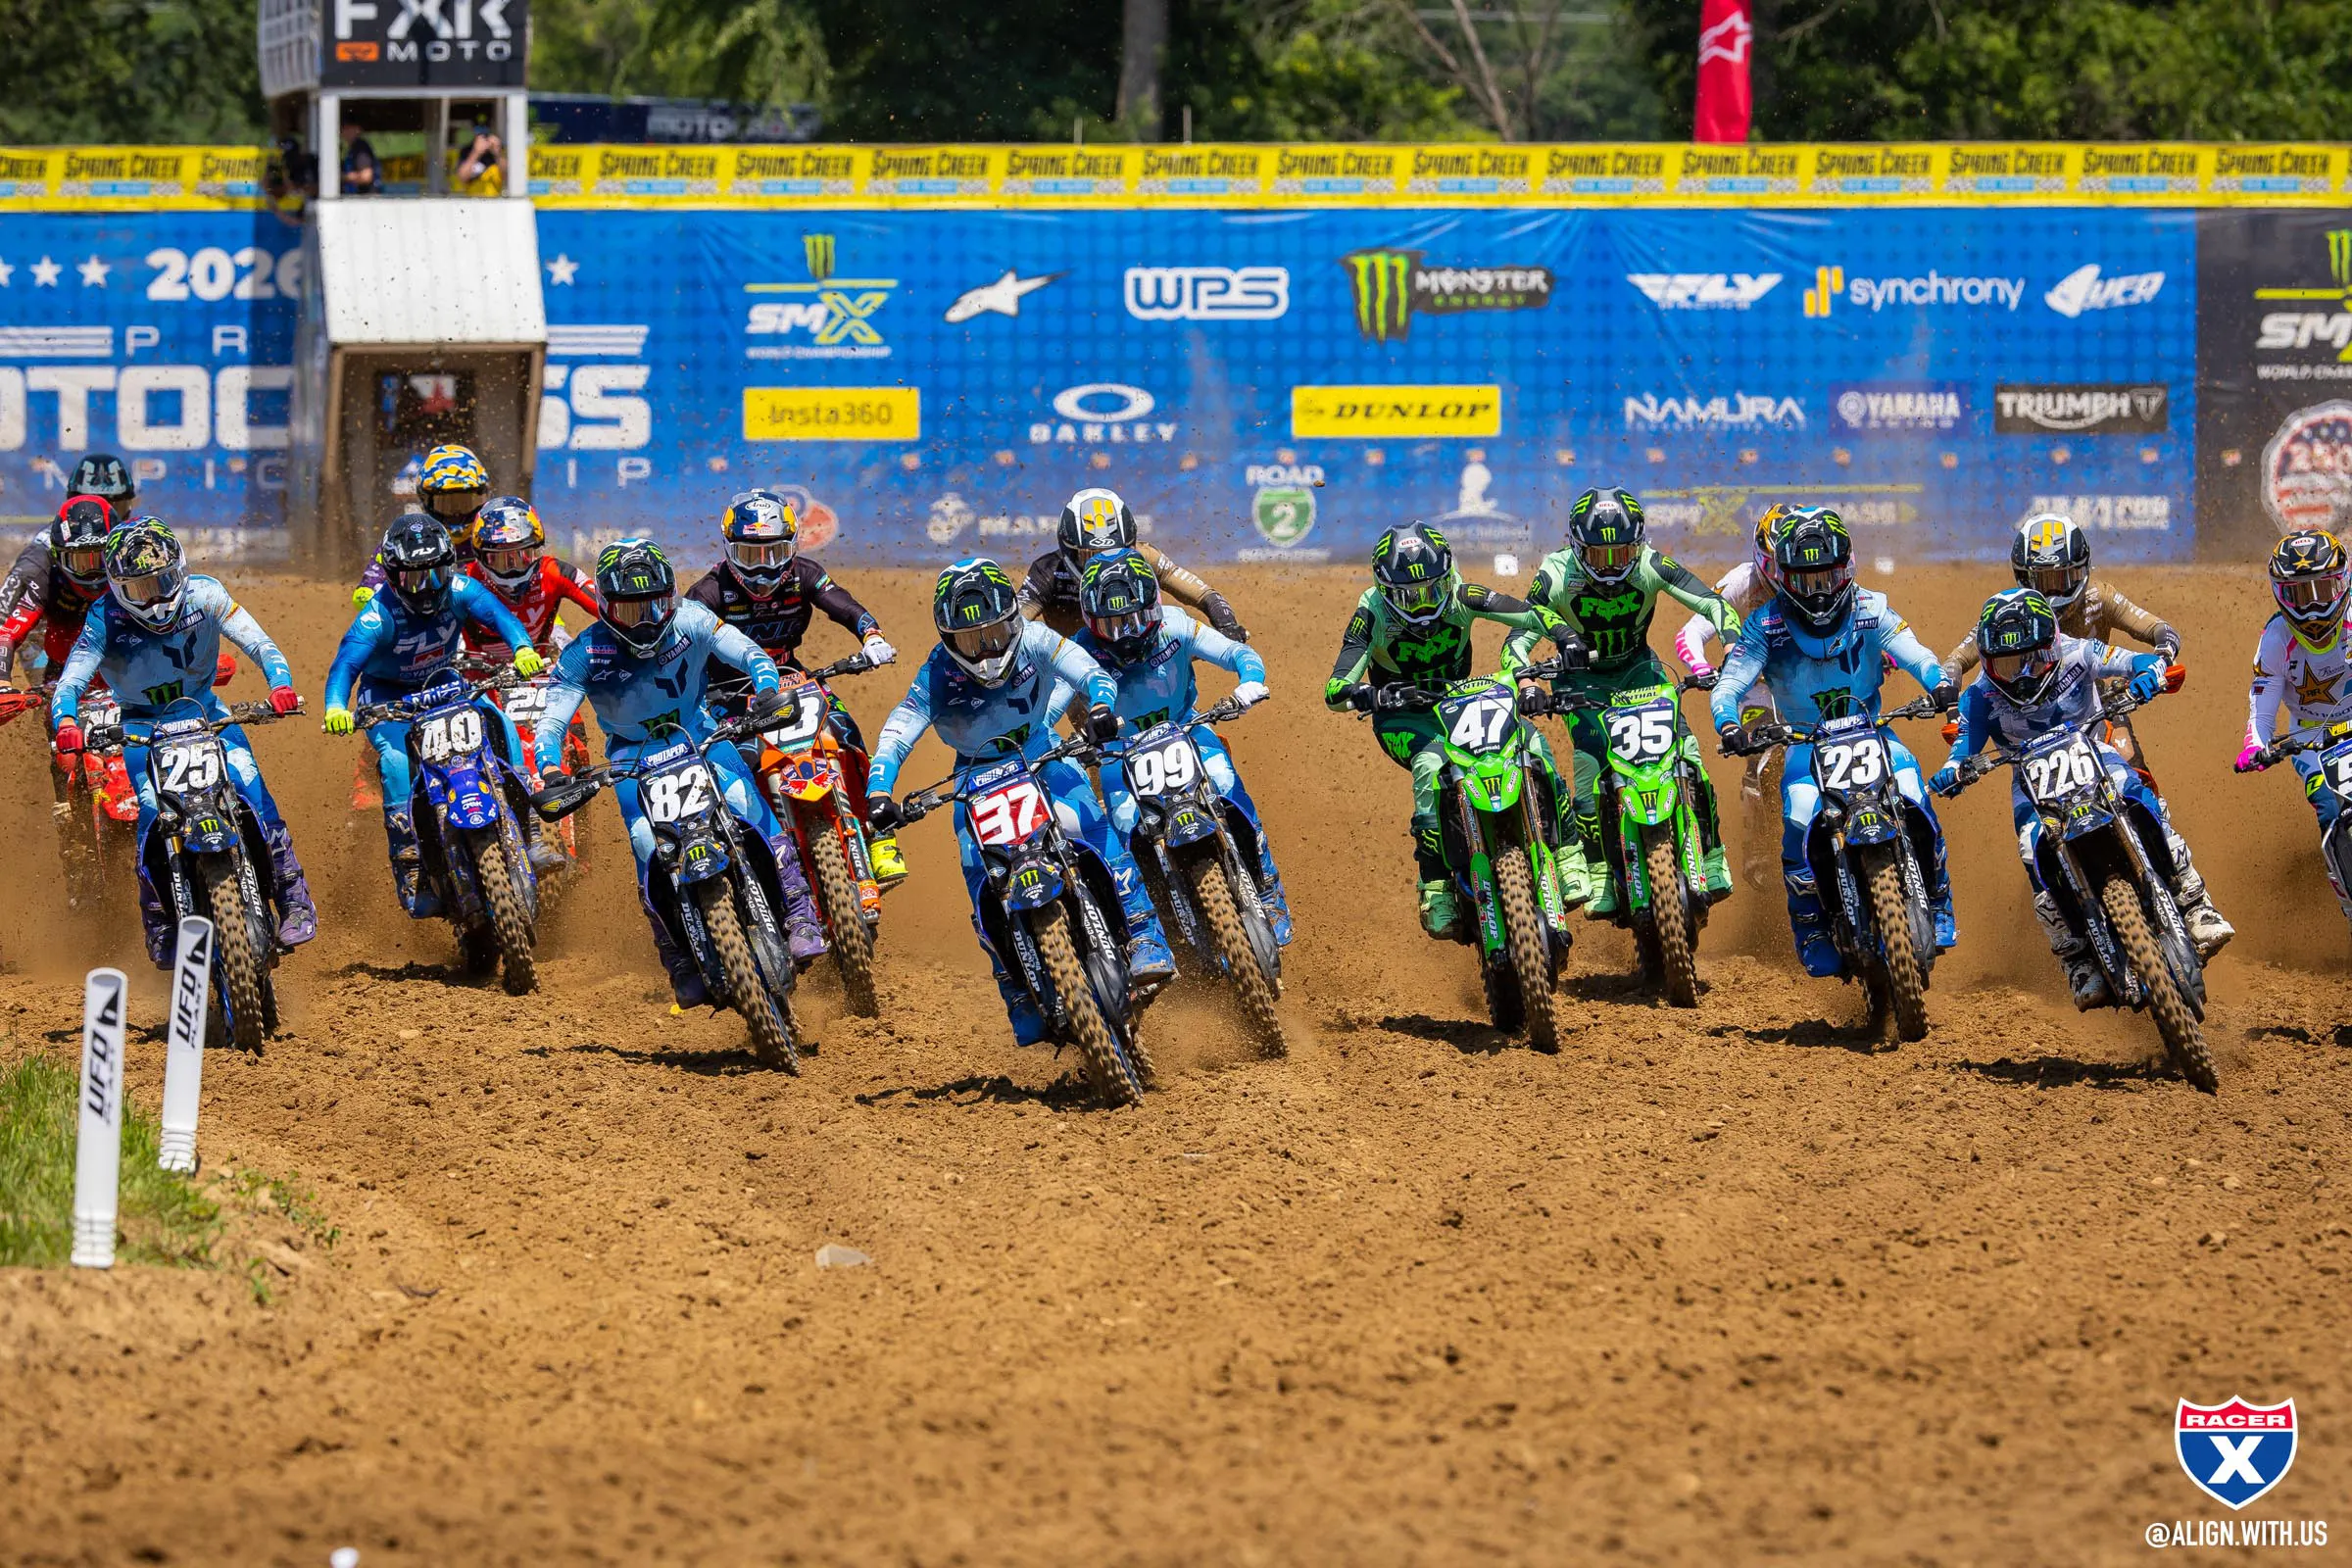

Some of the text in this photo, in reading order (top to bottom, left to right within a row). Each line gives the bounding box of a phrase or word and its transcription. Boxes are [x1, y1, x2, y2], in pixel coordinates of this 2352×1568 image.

[386, 40, 513, 62] MOTO
[1125, 267, 1290, 319] WPS
[1414, 268, 1549, 294] MONSTER
[1849, 269, 2027, 312] synchrony
[745, 291, 889, 344] SMX
[2256, 311, 2352, 363] SM
[1334, 403, 1492, 419] DUNLOP
[1624, 391, 1807, 424] NAMURA
[1866, 392, 1961, 419] YAMAHA
[1995, 392, 2132, 421] TRIUMPH
[1029, 422, 1177, 443] OAKLEY
[1246, 465, 1323, 488] ROAD
[1271, 500, 1298, 538] 2
[411, 546, 435, 558] FLY
[392, 620, 458, 655] FLY
[2057, 665, 2084, 695] YAMAHA
[420, 710, 482, 761] 40
[1449, 697, 1513, 749] 47
[1610, 710, 1673, 761] 35
[161, 741, 220, 793] 25
[1134, 740, 1195, 796] 99
[1824, 738, 1883, 790] 23
[2030, 742, 2095, 801] 226
[649, 764, 710, 823] 82
[974, 782, 1041, 845] 37
[1483, 879, 1499, 941] DUNLOP
[1838, 868, 1856, 926] DUNLOP
[1084, 899, 1117, 961] DUNLOP
[1012, 930, 1041, 993] DUNLOP
[176, 967, 198, 1045] UFO
[87, 1030, 109, 1118] UFO
